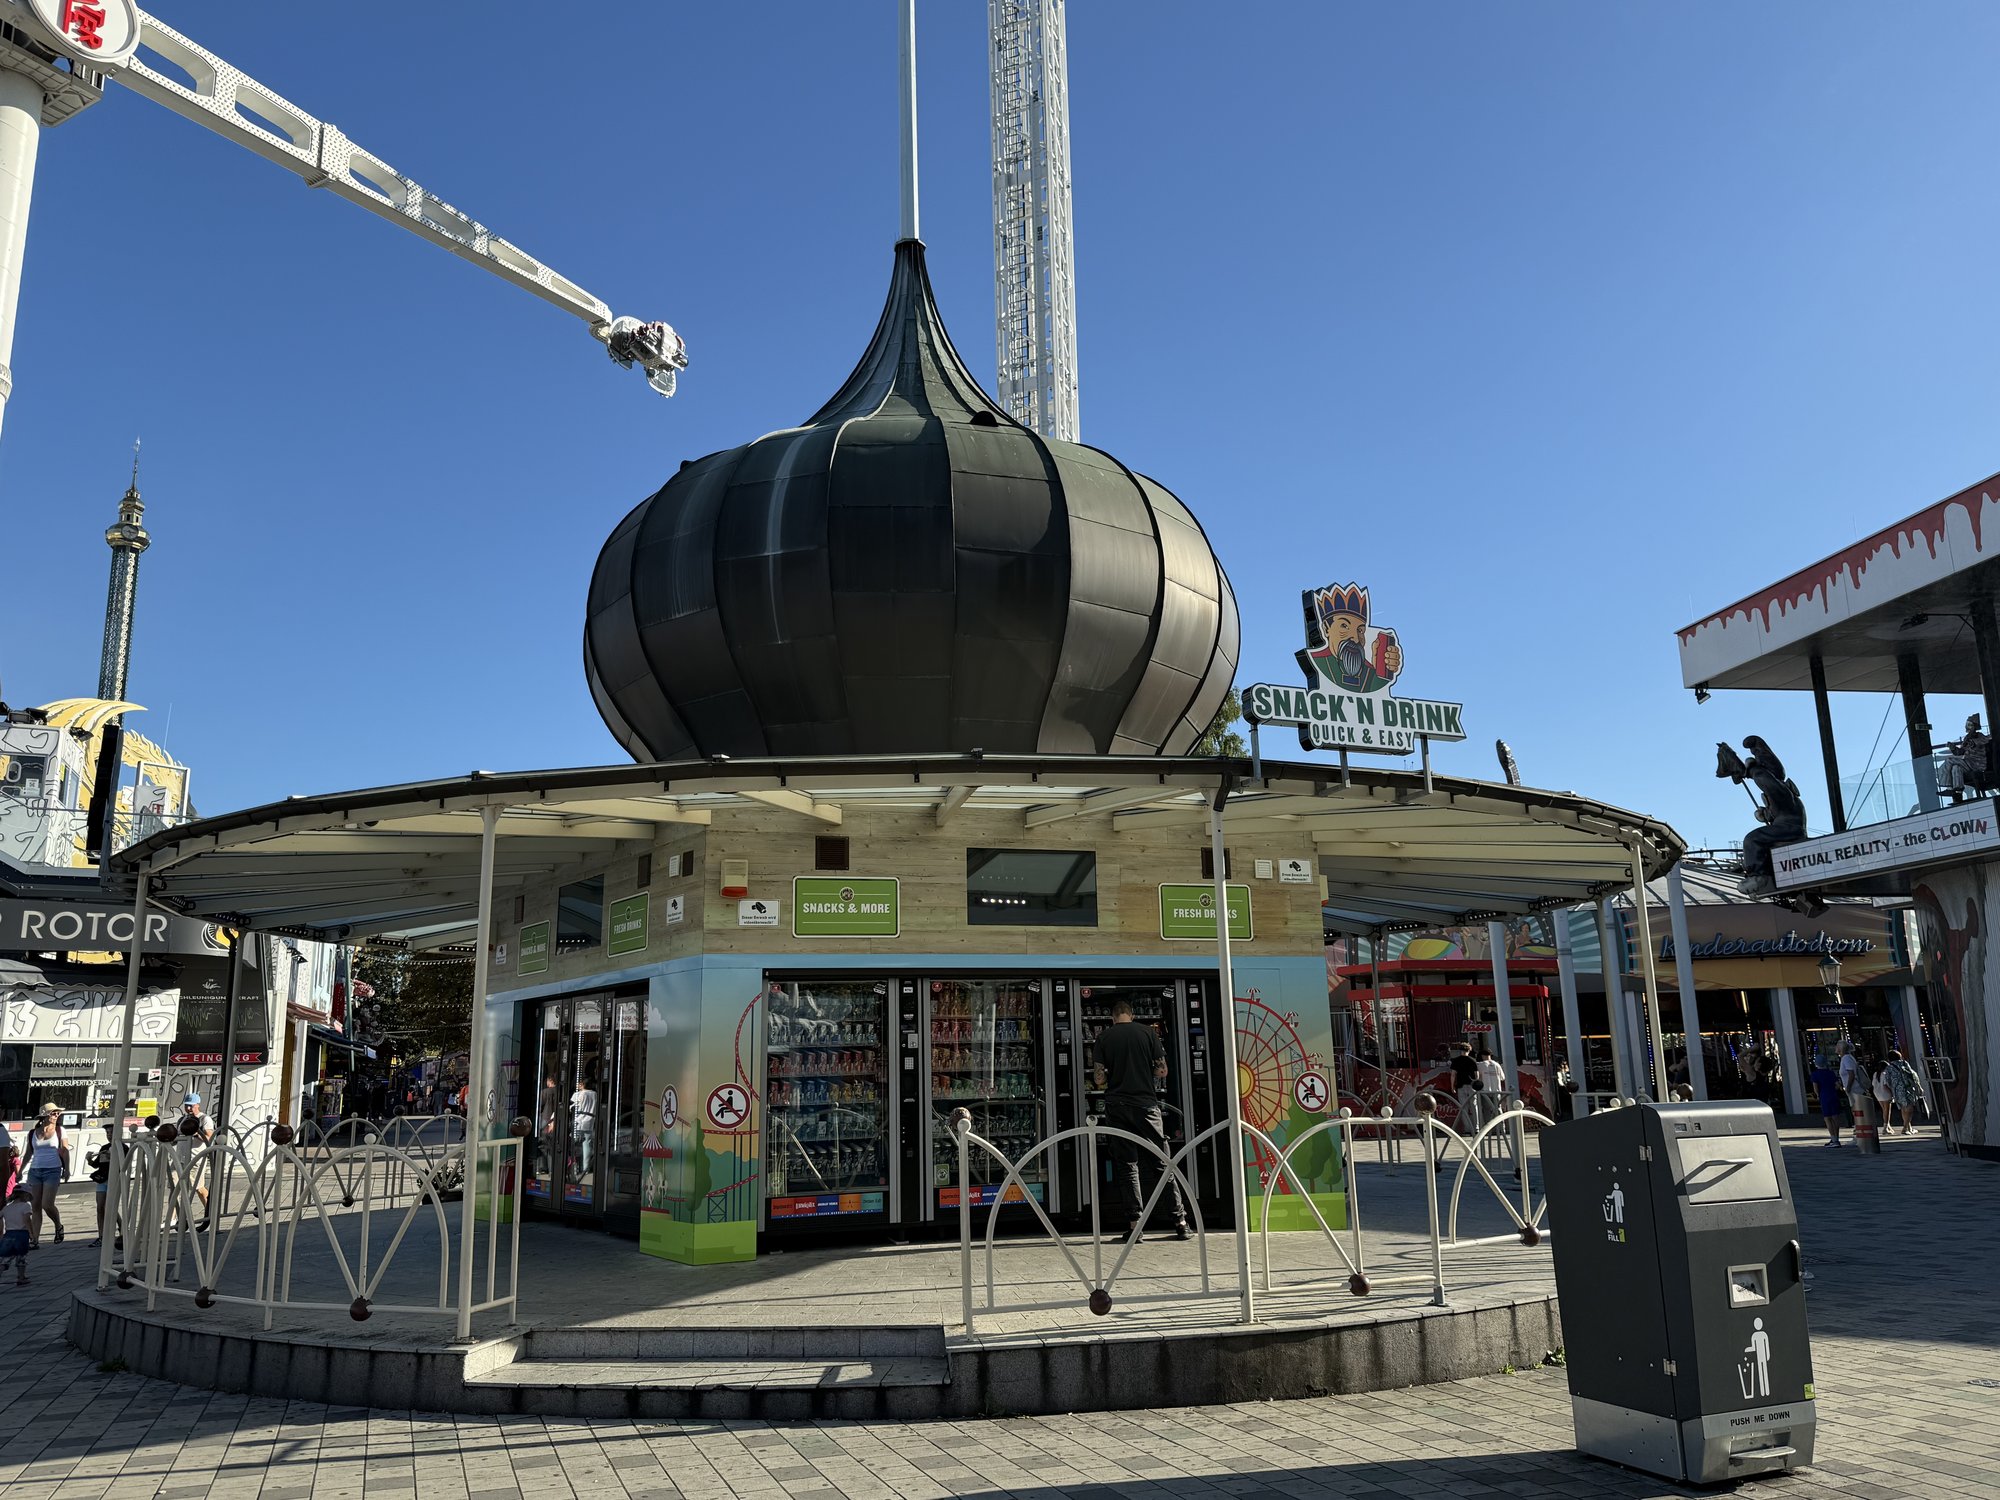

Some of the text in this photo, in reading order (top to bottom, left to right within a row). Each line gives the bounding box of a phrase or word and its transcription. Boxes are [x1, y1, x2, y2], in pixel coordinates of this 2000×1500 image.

[1382, 699, 1462, 734] DRINK
[1313, 723, 1413, 748] QUICK & EASY
[1780, 852, 1832, 872] VIRTUAL
[1835, 838, 1890, 861] REALITY
[1903, 832, 1927, 847] the
[1930, 819, 1988, 841] CLOWN
[803, 902, 890, 914] SNACKS & MORE
[1173, 908, 1238, 919] FRESH DRKS
[20, 910, 168, 942] ROTOR
[613, 922, 627, 935] FRESH
[1660, 930, 1877, 958] Knderautodrom
[193, 1054, 250, 1062] EINGNG
[1730, 1410, 1790, 1427] PUSH ME DOWN
